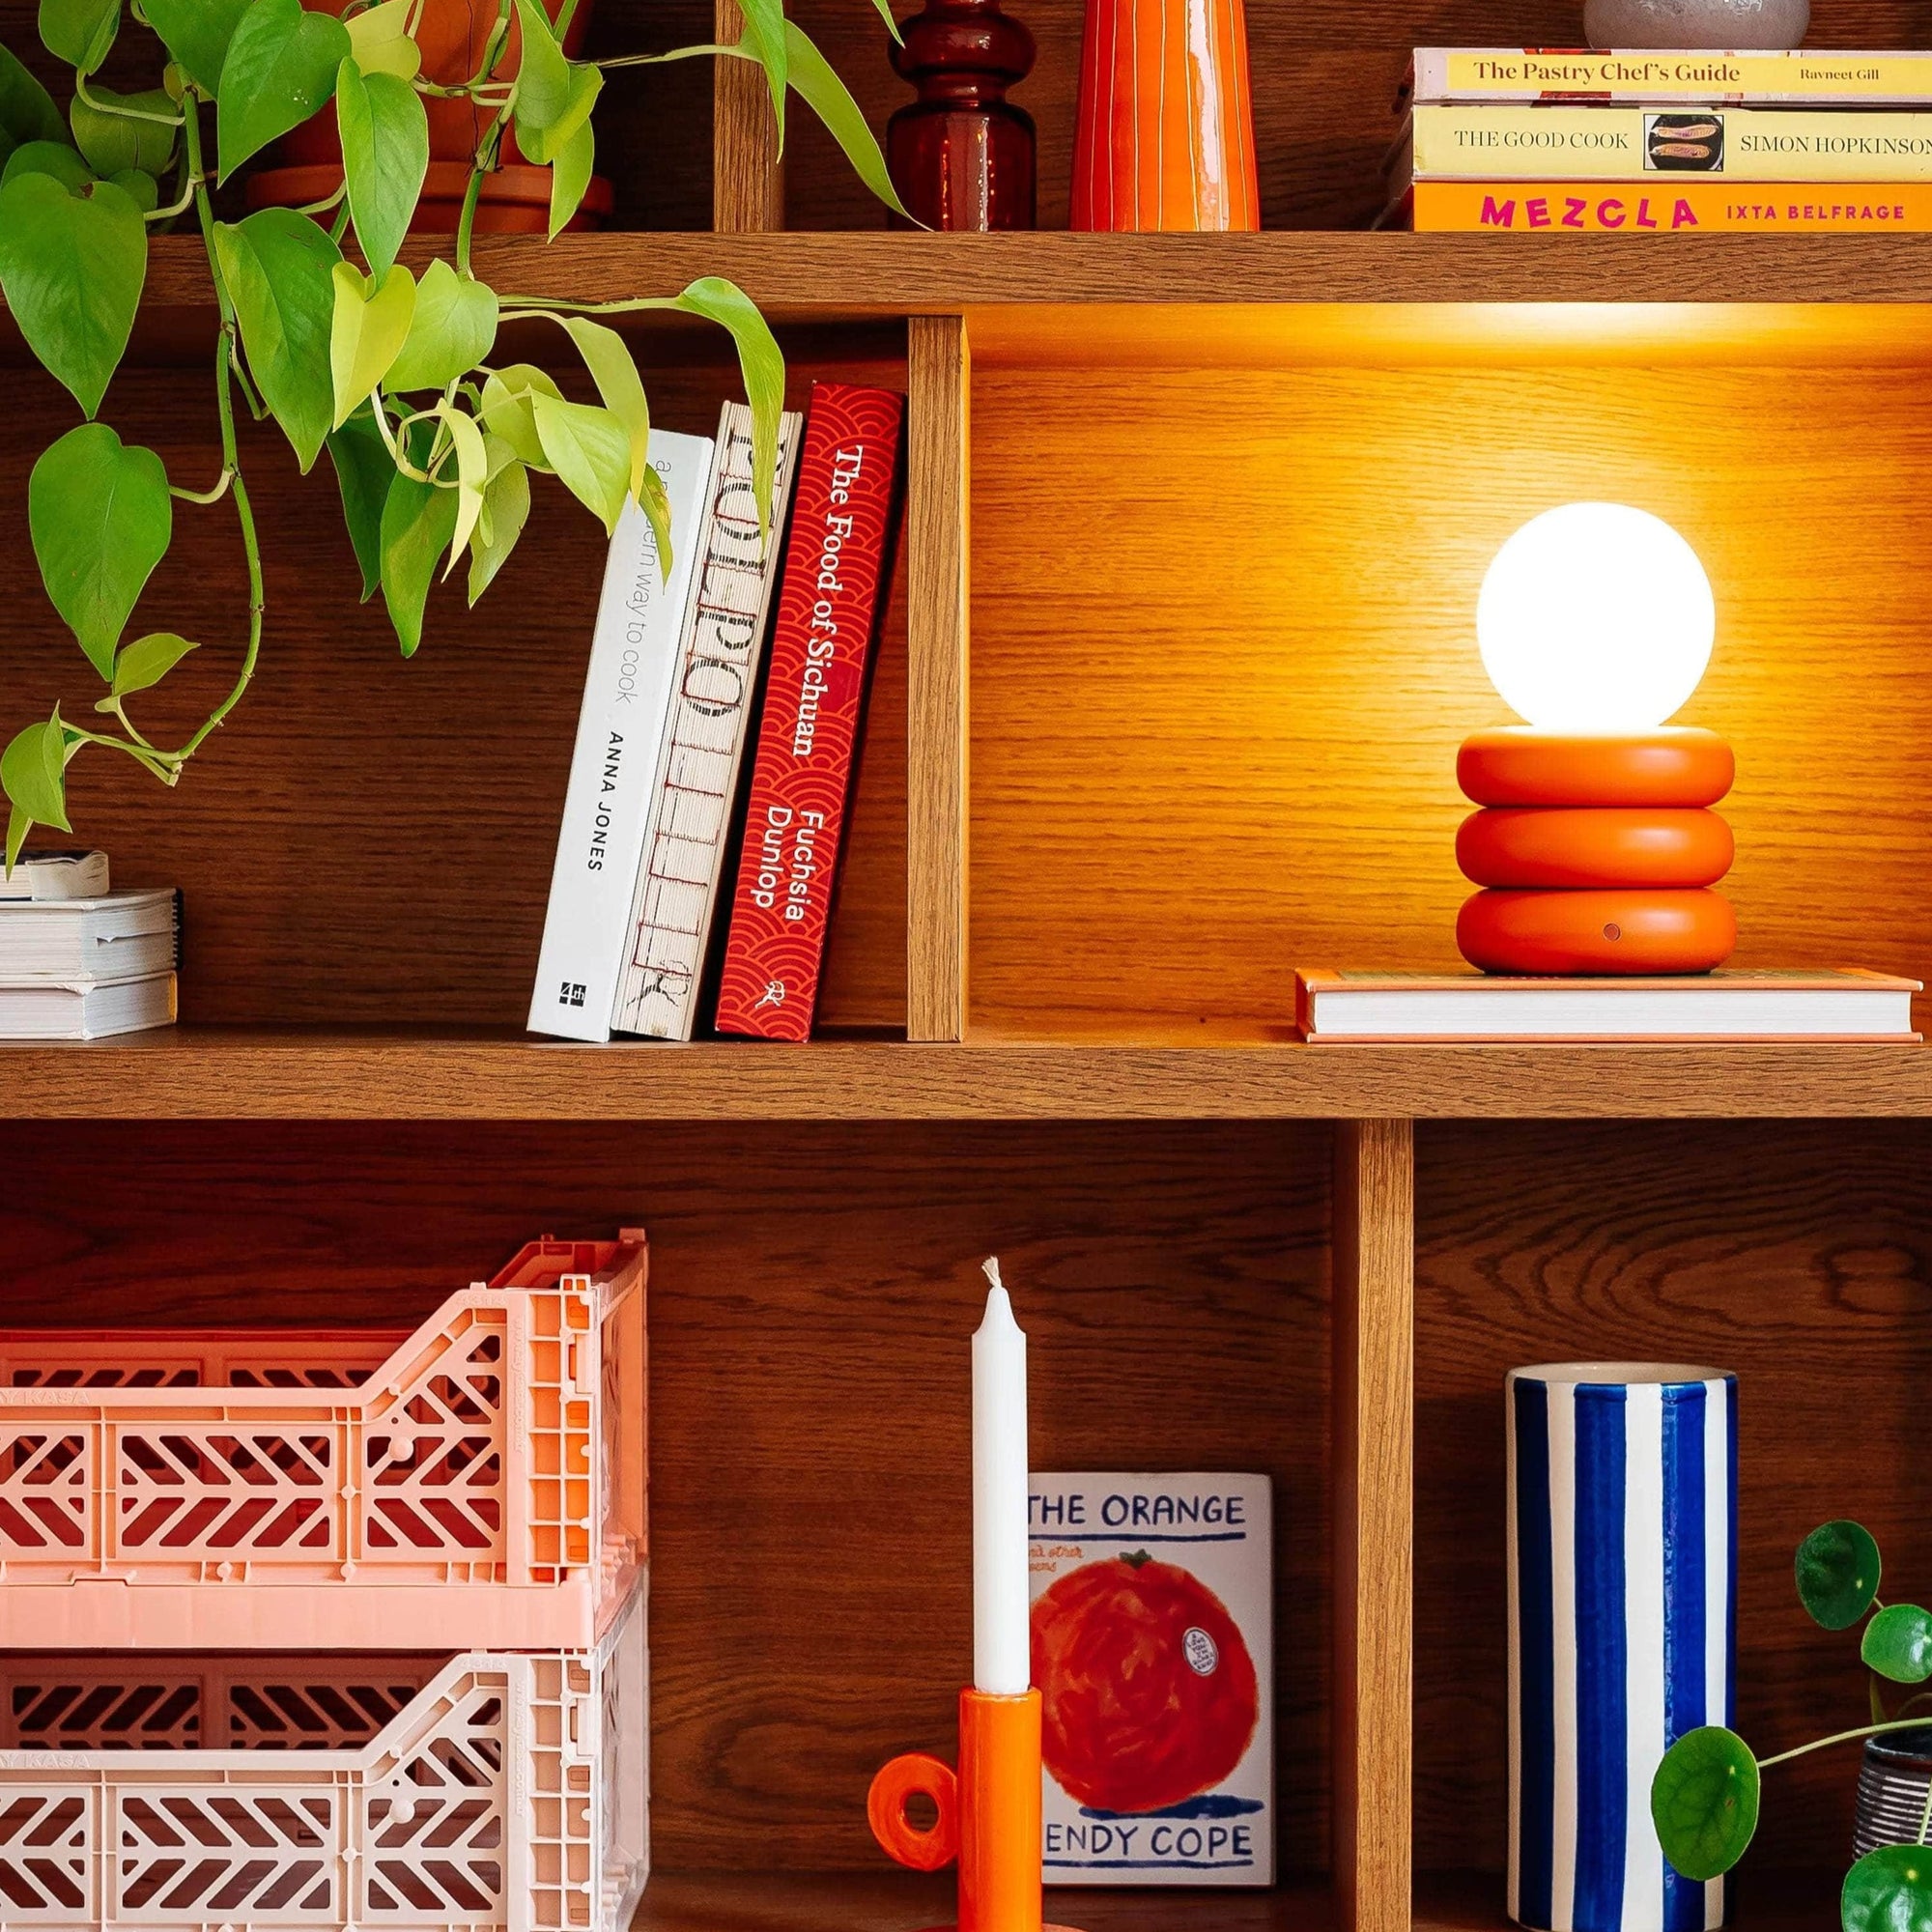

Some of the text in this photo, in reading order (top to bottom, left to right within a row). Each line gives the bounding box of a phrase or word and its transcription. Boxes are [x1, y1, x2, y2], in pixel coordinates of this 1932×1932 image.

[1473, 62, 1741, 85] The Pastry Chef's Guide
[1800, 68, 1879, 80] Ravneet Gill
[1454, 129, 1629, 150] THE GOOD COOK
[1740, 135, 1809, 153] SIMON
[1480, 195, 1698, 229] MEZCLA
[1727, 205, 1904, 220] IXTA BELFRAGE
[655, 460, 671, 473] a
[625, 572, 653, 617] way
[792, 444, 864, 756] The Food of Sichuan
[626, 622, 646, 644] to
[614, 649, 639, 704] cook
[587, 730, 624, 871] ANNA JONES
[750, 806, 793, 908] Dunlop
[784, 810, 824, 921] Fuchsia
[1028, 1493, 1246, 1526] THE ORANGE
[1046, 1823, 1253, 1857] ENDY COPE
